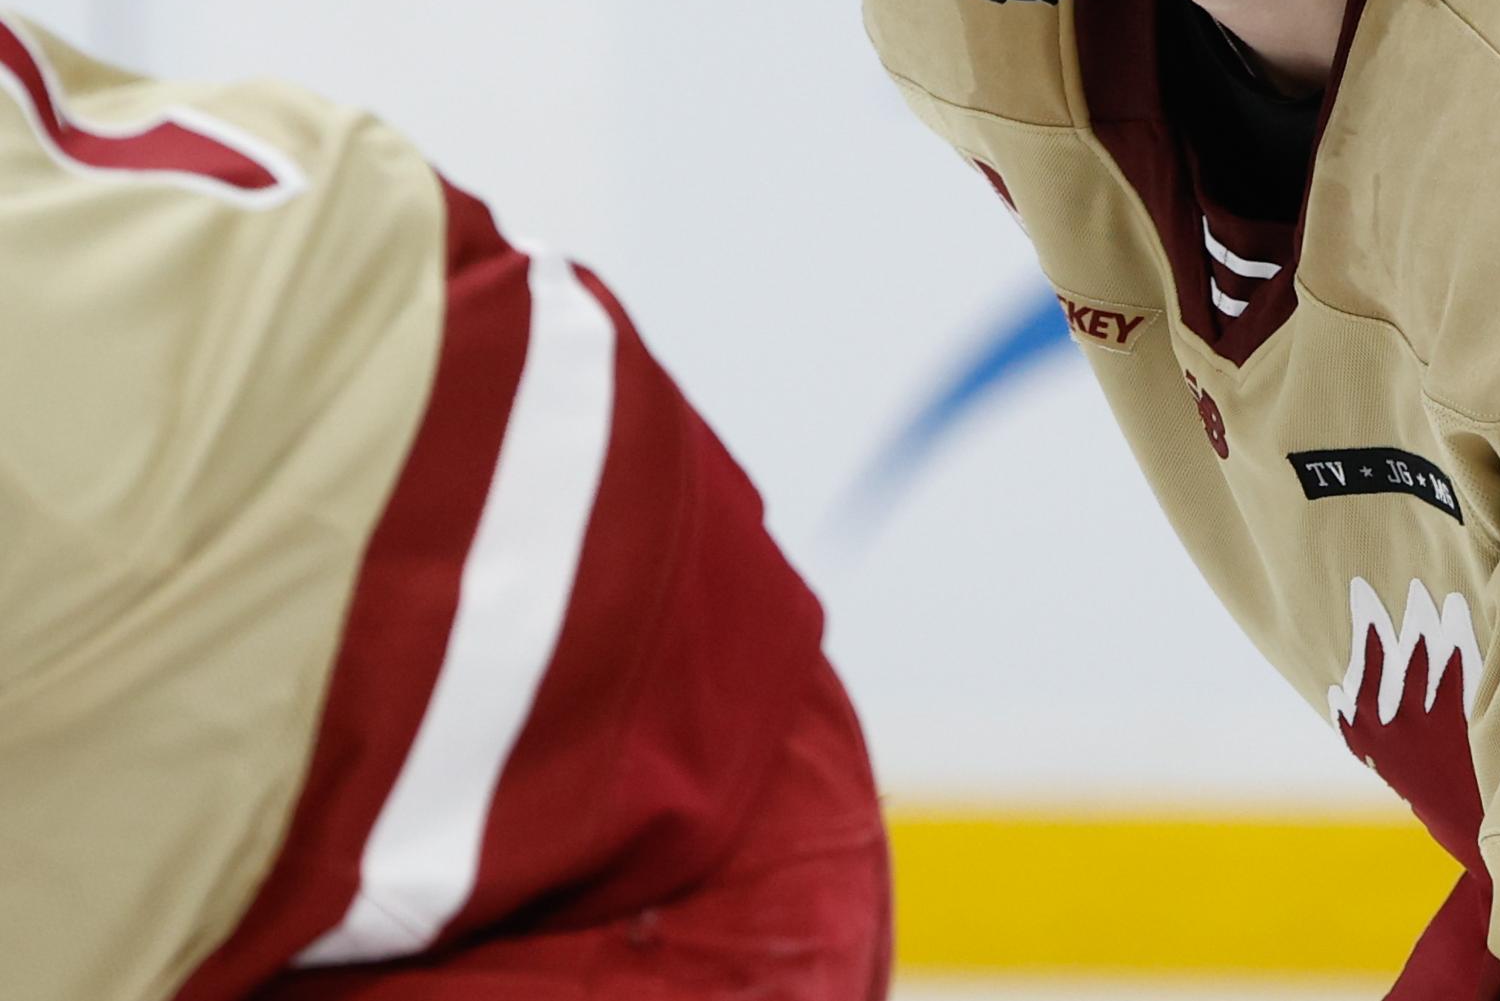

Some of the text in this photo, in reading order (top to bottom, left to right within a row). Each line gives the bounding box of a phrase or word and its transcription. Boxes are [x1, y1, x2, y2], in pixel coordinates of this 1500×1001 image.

[1057, 294, 1144, 344] KEY
[1306, 461, 1346, 487] TV
[1386, 459, 1413, 487] JG
